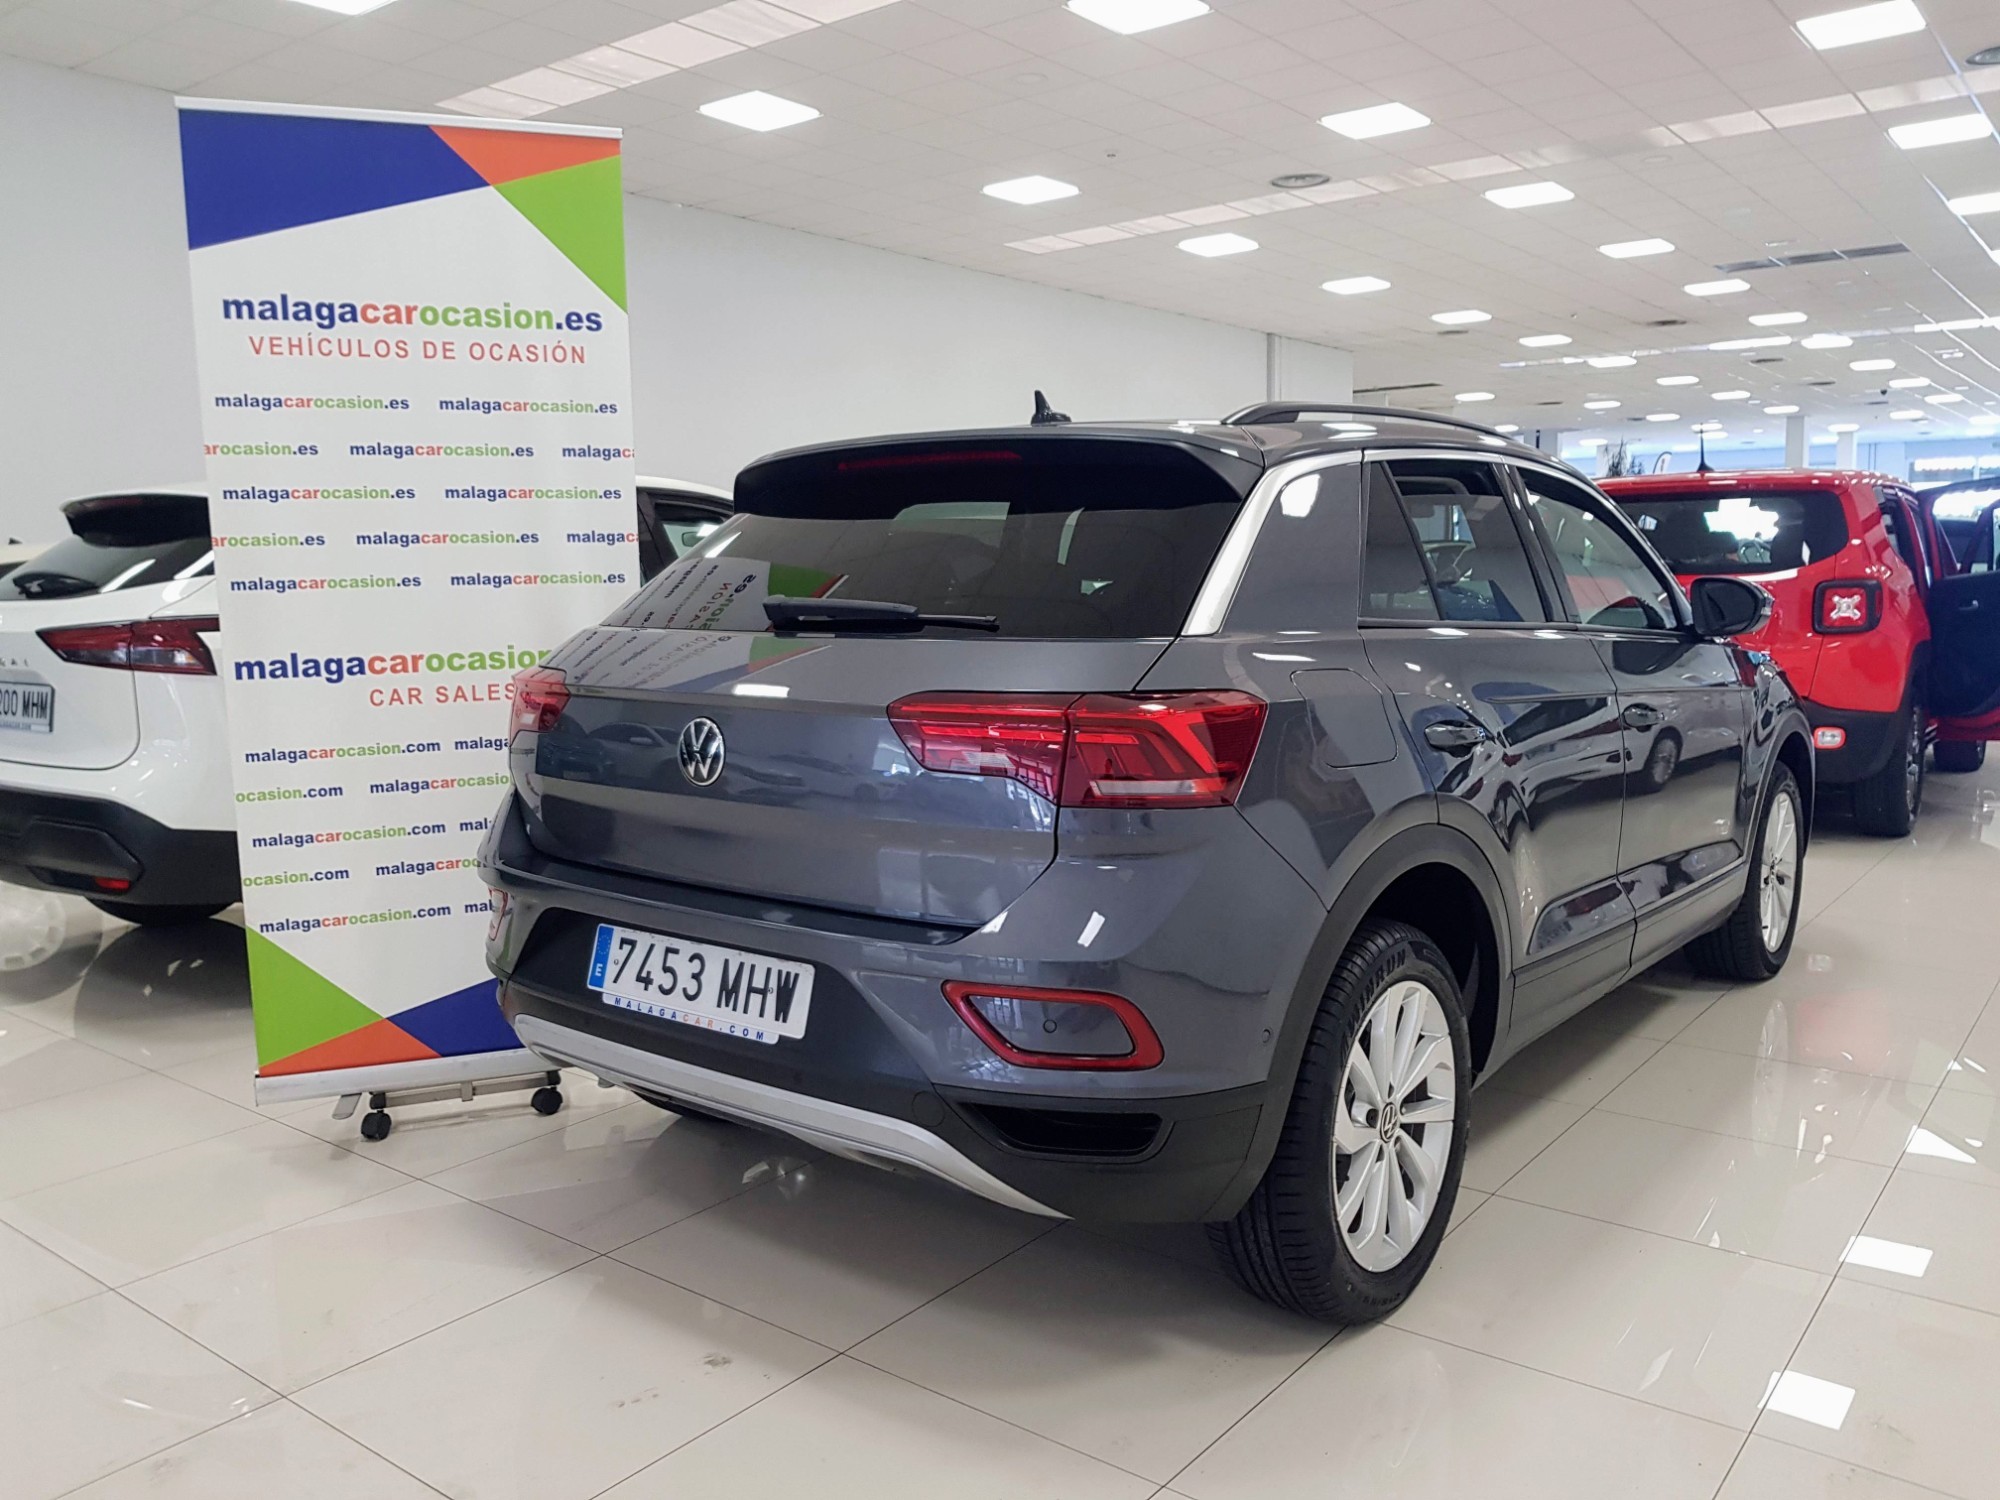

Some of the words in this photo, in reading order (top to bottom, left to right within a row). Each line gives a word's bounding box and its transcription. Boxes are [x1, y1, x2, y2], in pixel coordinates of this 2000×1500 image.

[223, 294, 603, 331] malagacarocasion.es
[249, 332, 409, 359] VEHÍCULOS
[423, 340, 456, 360] DE
[468, 338, 585, 364] OCASIÓN
[215, 394, 409, 411] malagacarocasion.es
[439, 397, 618, 415] malagacarocasion.es
[350, 442, 534, 458] malagacarocasion.es
[562, 445, 634, 461] malagac
[223, 486, 416, 503] malagacarocasion.es
[445, 486, 622, 502] malagacarocasion.es
[357, 531, 539, 548] malagacarocasion.es
[231, 575, 421, 593] malagacarocasion.es
[451, 572, 626, 588] malagacarocasion.es
[370, 688, 423, 707] CAR
[436, 683, 514, 703] SALES
[245, 741, 441, 763] malagacarocasion.com
[235, 787, 343, 803] ocasion.com
[252, 823, 446, 848] malagacarocasion.com
[243, 870, 349, 887] ocasion.com
[260, 903, 451, 933] malagacarocasion.com
[594, 962, 603, 977] E
[612, 937, 706, 1002] 7453
[716, 958, 800, 1024] MHW
[614, 997, 764, 1041] MALAGACAR.COM
